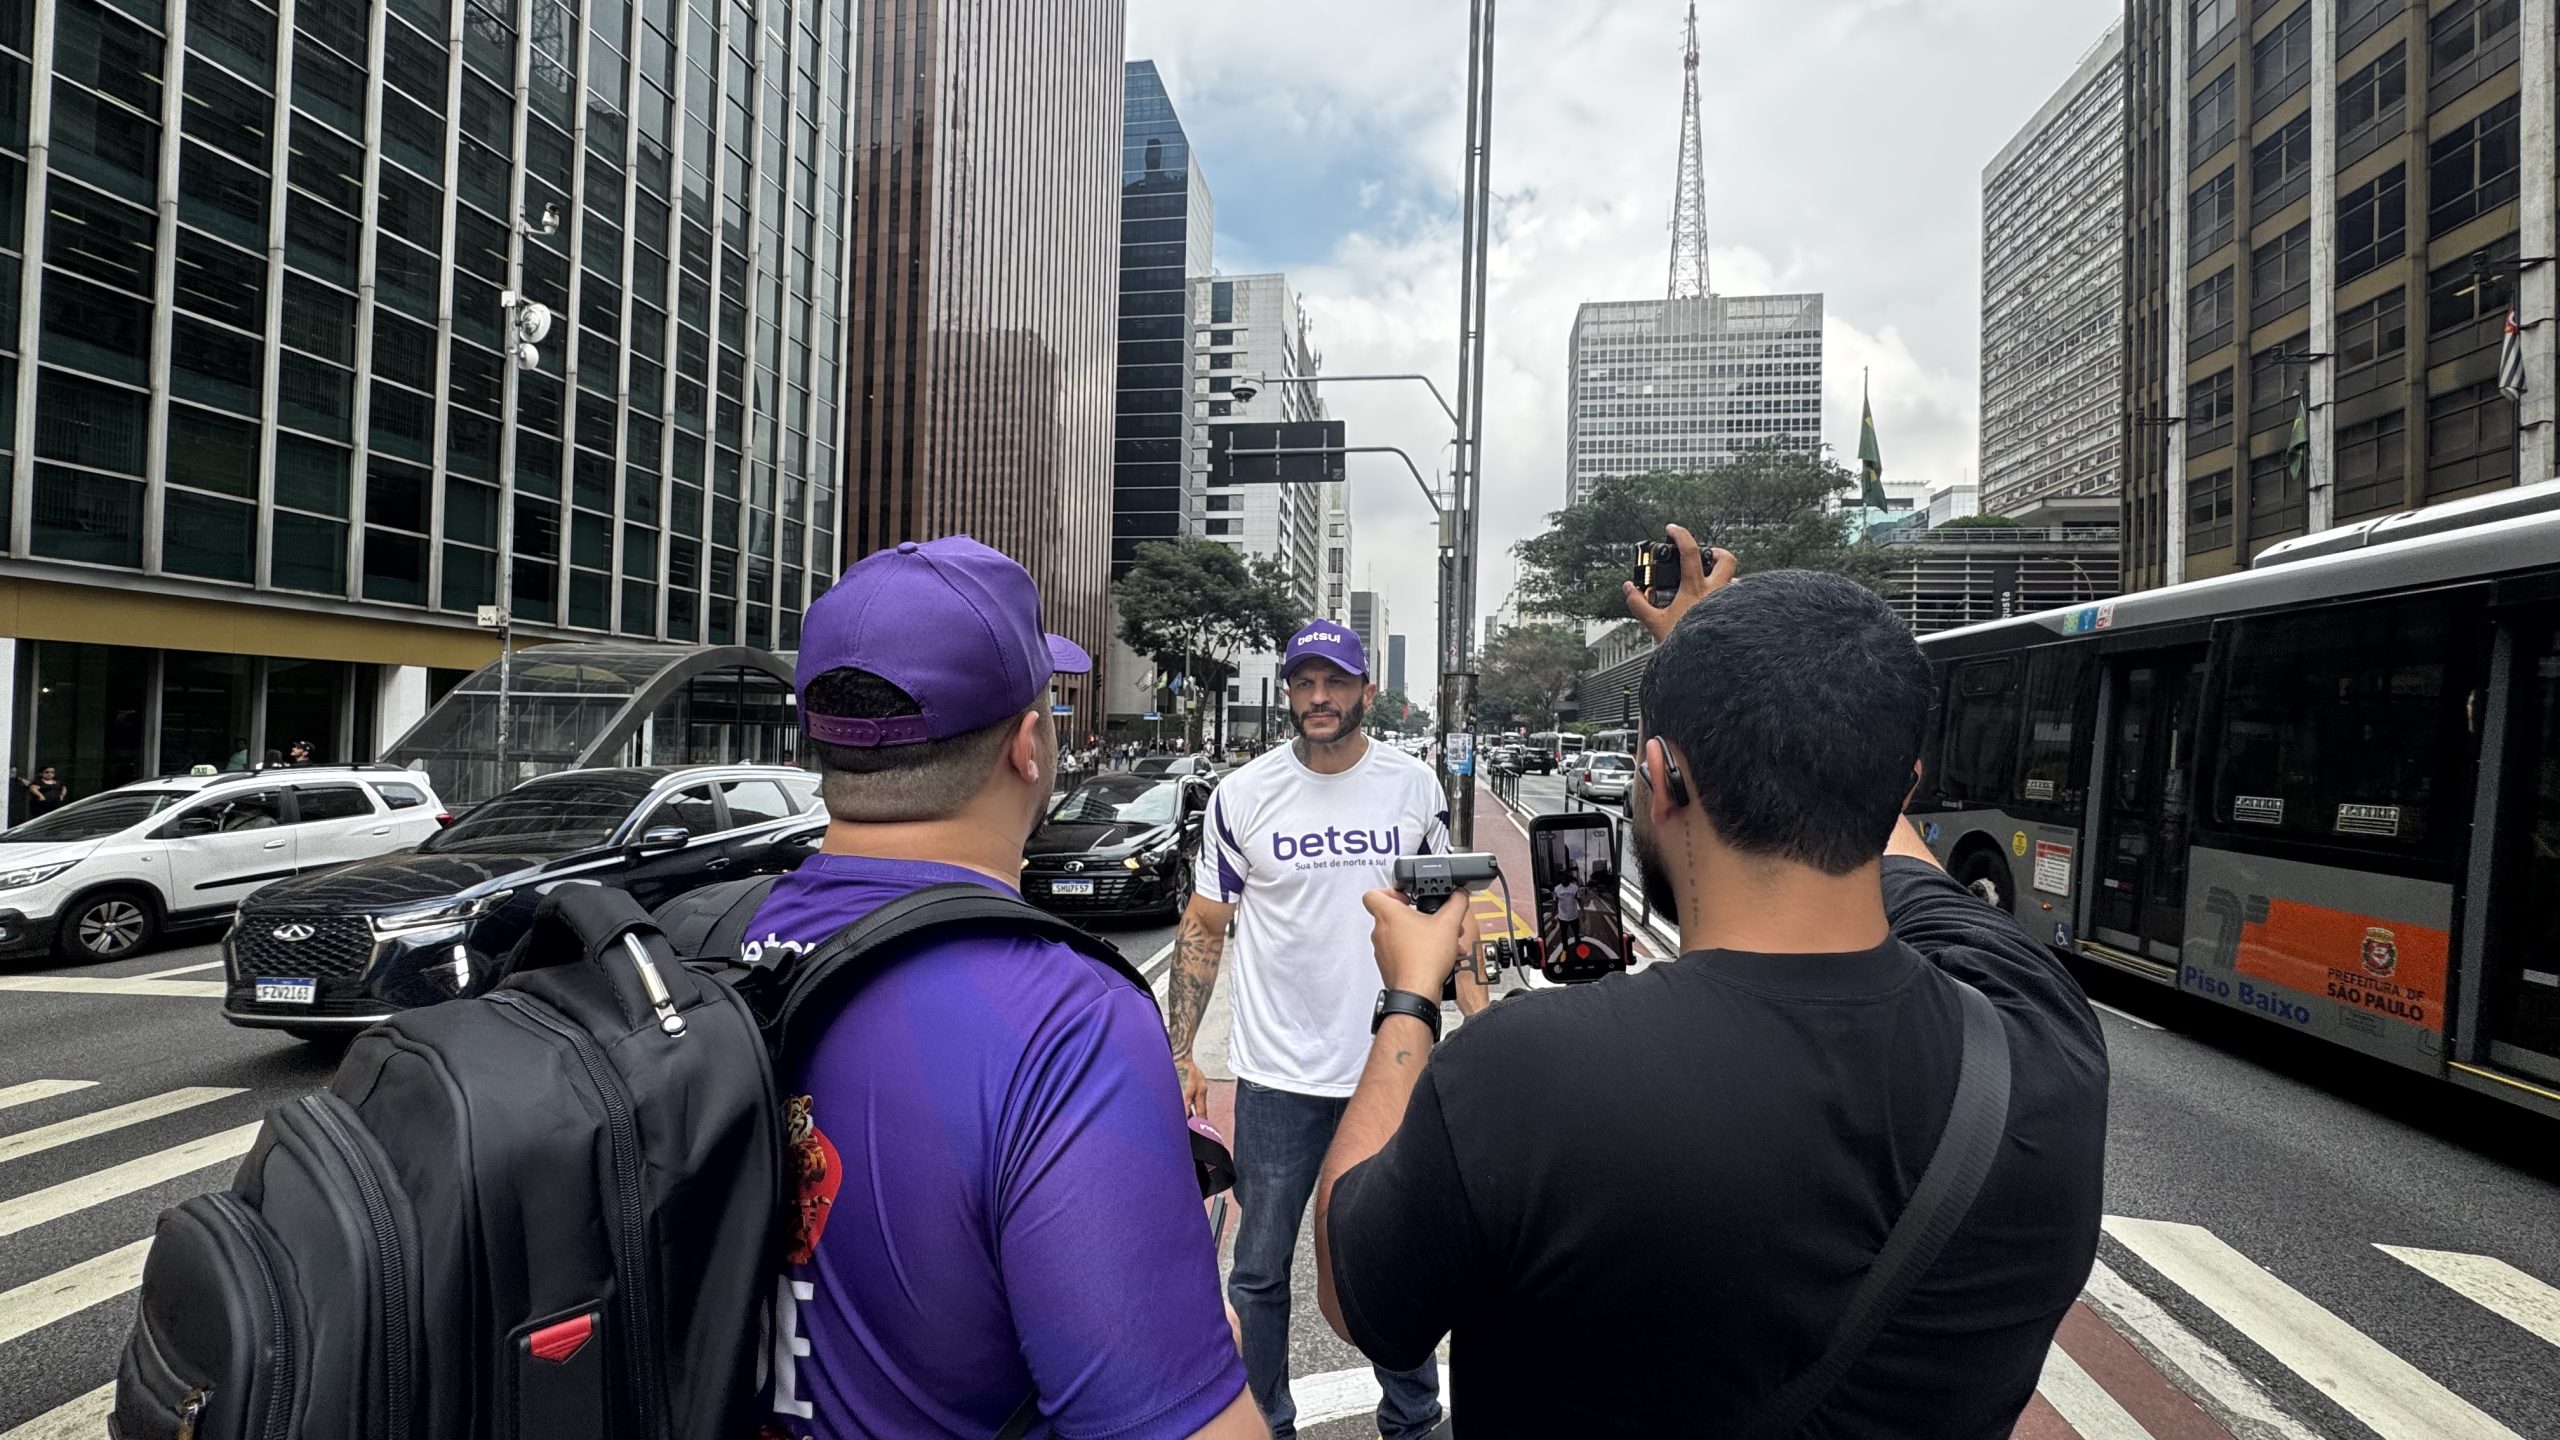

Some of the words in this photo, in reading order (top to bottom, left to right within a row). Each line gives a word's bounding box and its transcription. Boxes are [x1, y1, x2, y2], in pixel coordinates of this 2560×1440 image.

[1297, 631, 1341, 646] betsul
[1273, 826, 1400, 861] betsul
[1295, 862, 1311, 871] Sua
[1313, 861, 1327, 869] bet
[1329, 859, 1341, 868] de
[1343, 859, 1367, 867] norte
[1375, 858, 1387, 866] sul
[2184, 965, 2230, 998] Piso
[2239, 981, 2311, 1024] Baixo
[2327, 967, 2400, 996] PREFEITURA
[2327, 982, 2361, 1003] SÃO
[2365, 992, 2424, 1021] PAULO
